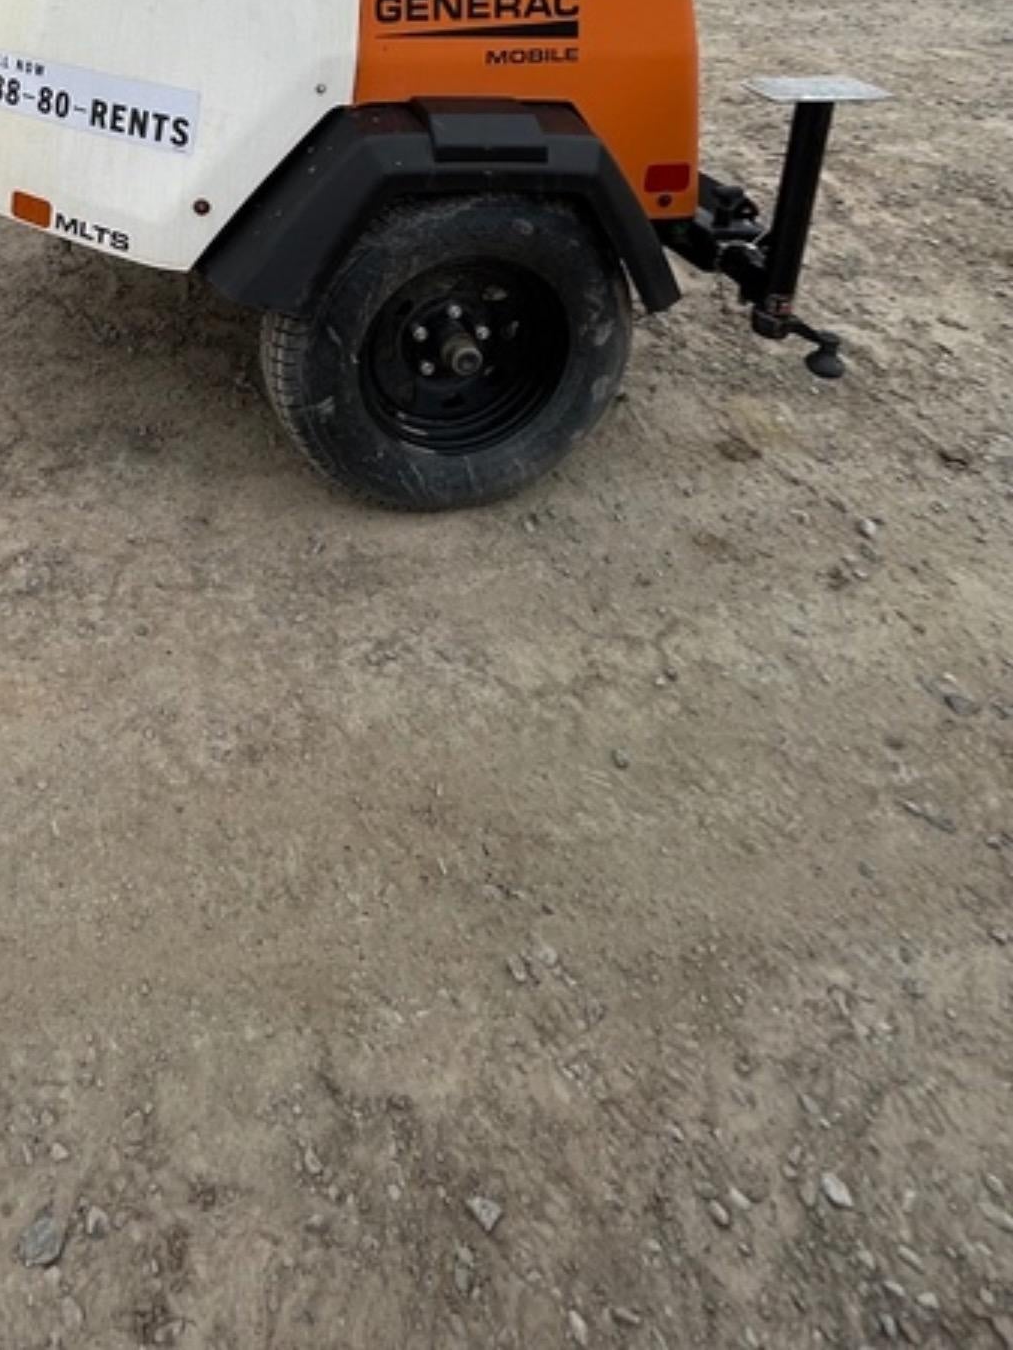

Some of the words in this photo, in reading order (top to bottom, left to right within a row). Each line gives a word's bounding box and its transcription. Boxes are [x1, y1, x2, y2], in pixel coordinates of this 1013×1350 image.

[485, 47, 580, 65] MOBILE
[15, 58, 45, 76] NOW
[54, 211, 130, 251] MLTS
